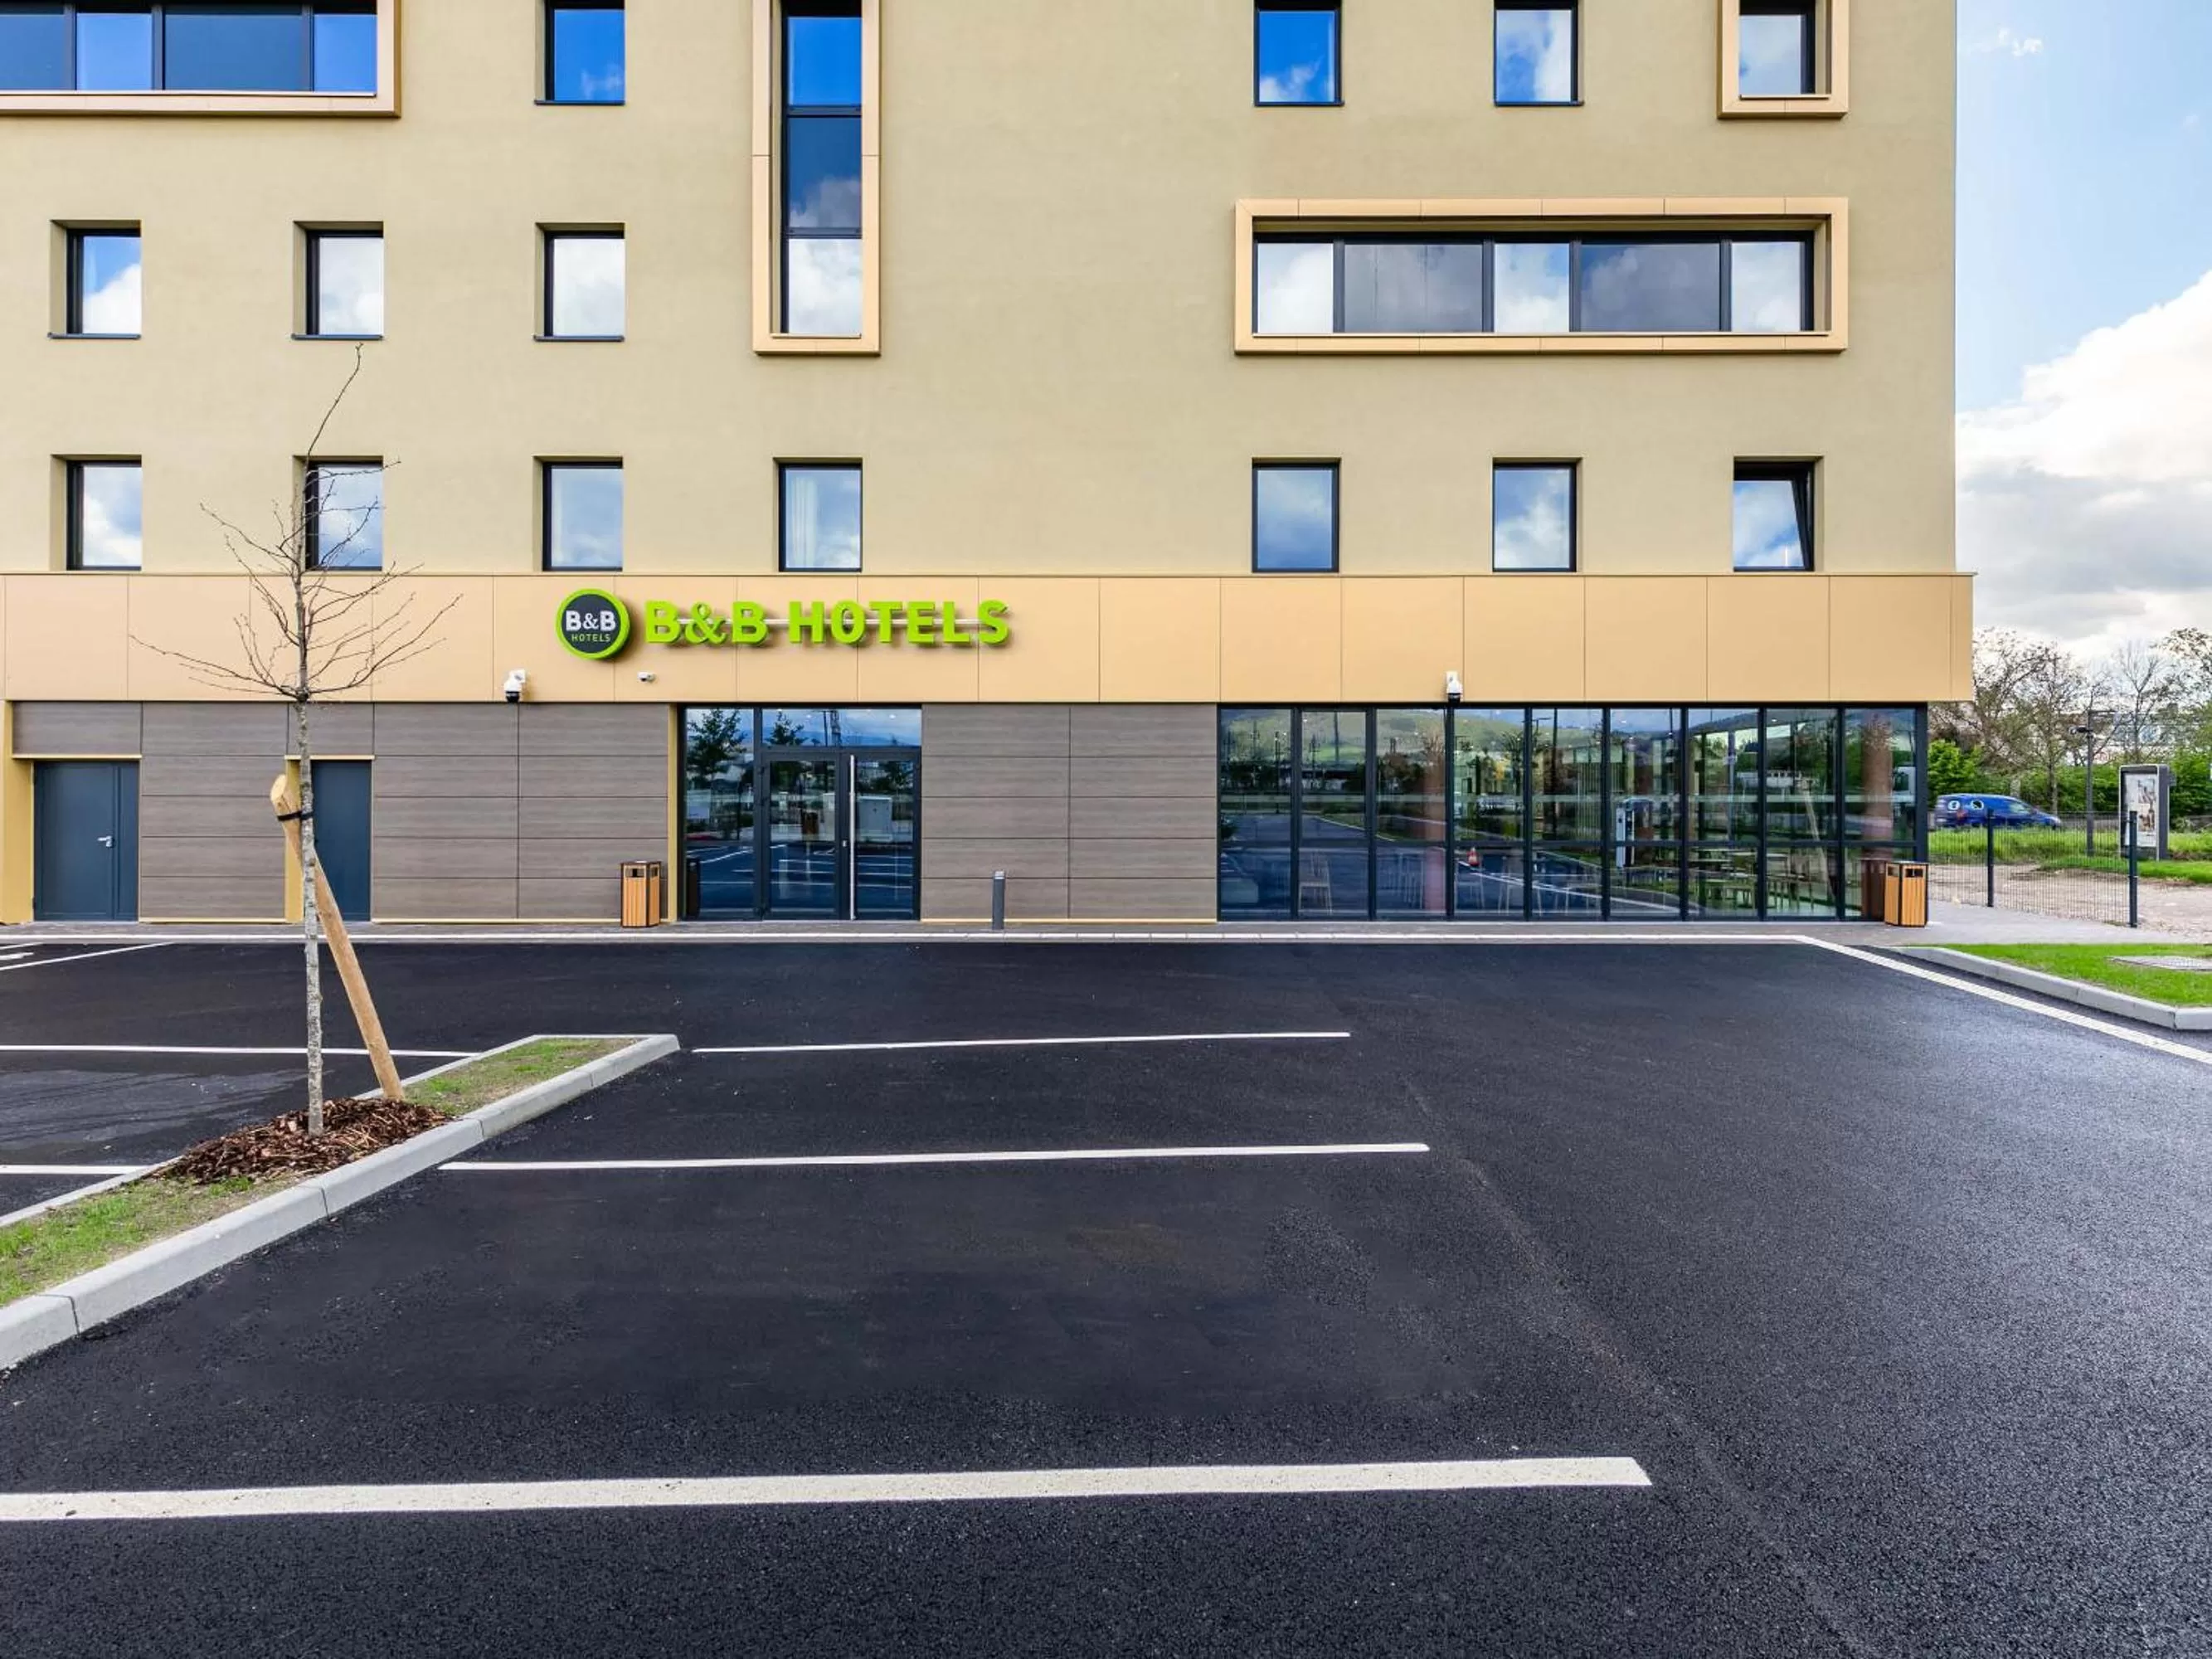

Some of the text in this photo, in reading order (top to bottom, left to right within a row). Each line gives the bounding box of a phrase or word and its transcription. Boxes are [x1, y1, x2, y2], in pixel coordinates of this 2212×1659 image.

[566, 610, 616, 631] B&B
[644, 601, 1010, 645] B&B HOTELS
[571, 633, 611, 643] HOTELS
